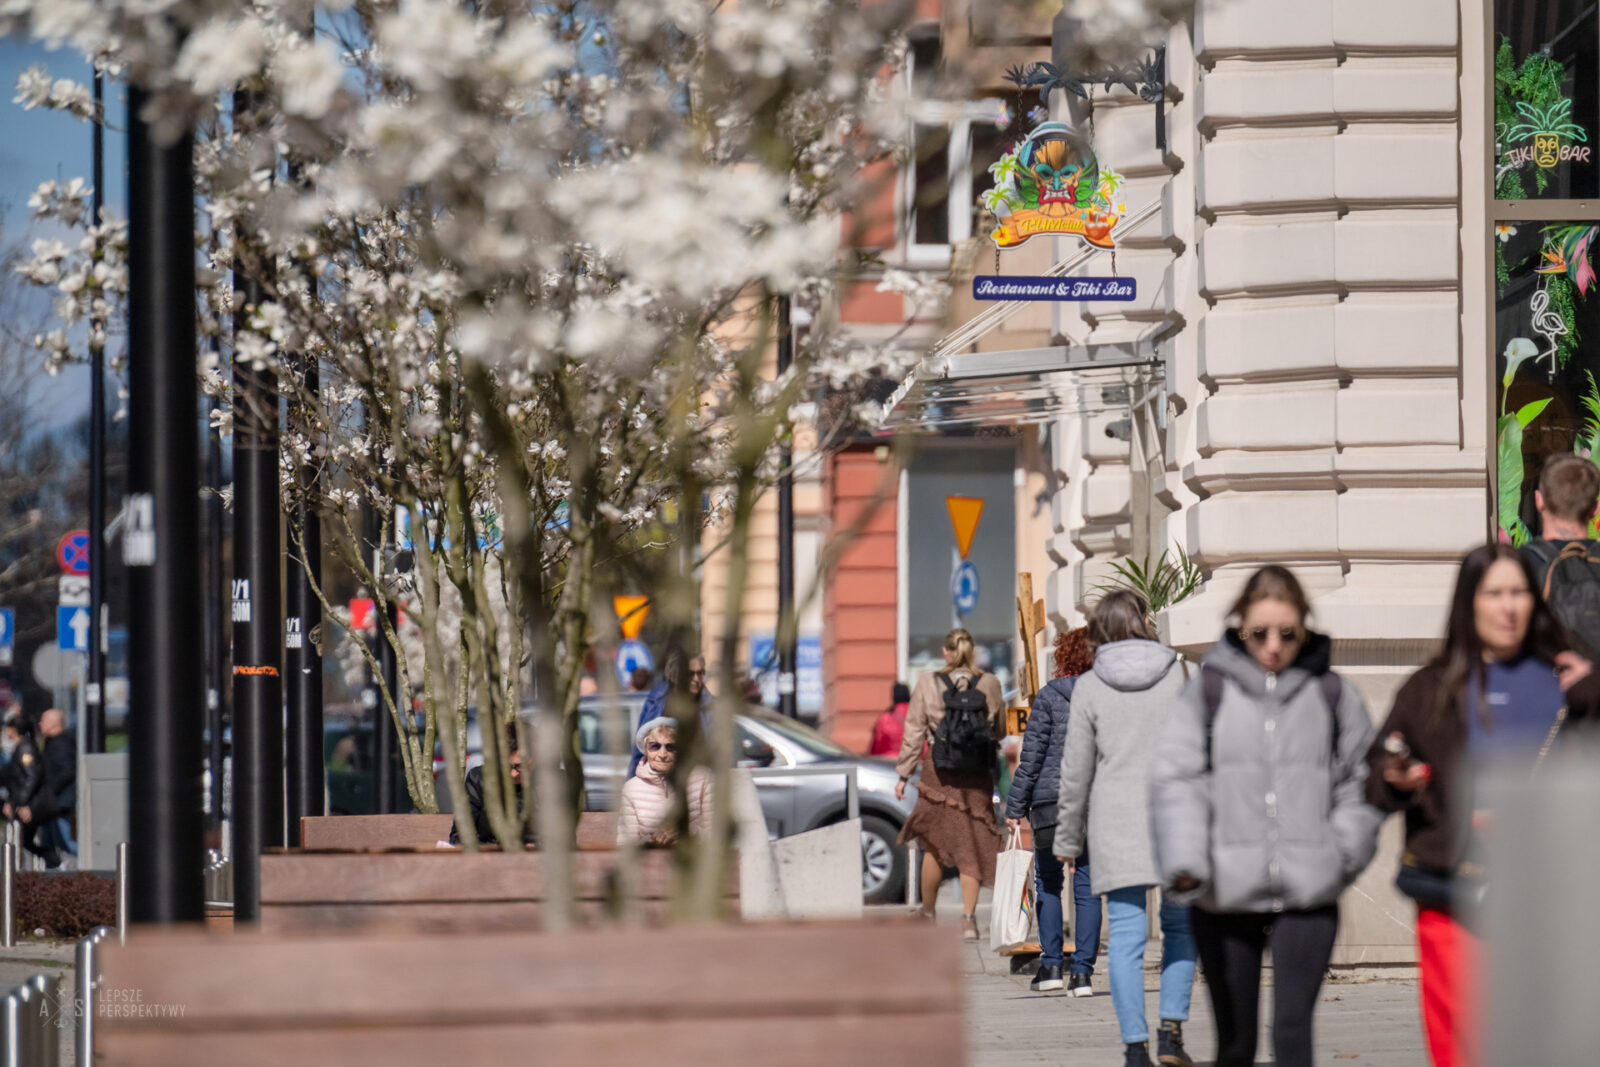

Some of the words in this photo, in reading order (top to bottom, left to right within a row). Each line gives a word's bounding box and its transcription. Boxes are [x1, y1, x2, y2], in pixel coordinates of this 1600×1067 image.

[1505, 146, 1534, 164] TIKI
[1560, 145, 1590, 163] BAR
[976, 280, 1055, 296] Restaurant
[1056, 282, 1069, 295] &
[1071, 281, 1100, 297] Tiki
[1102, 282, 1132, 297] Bar
